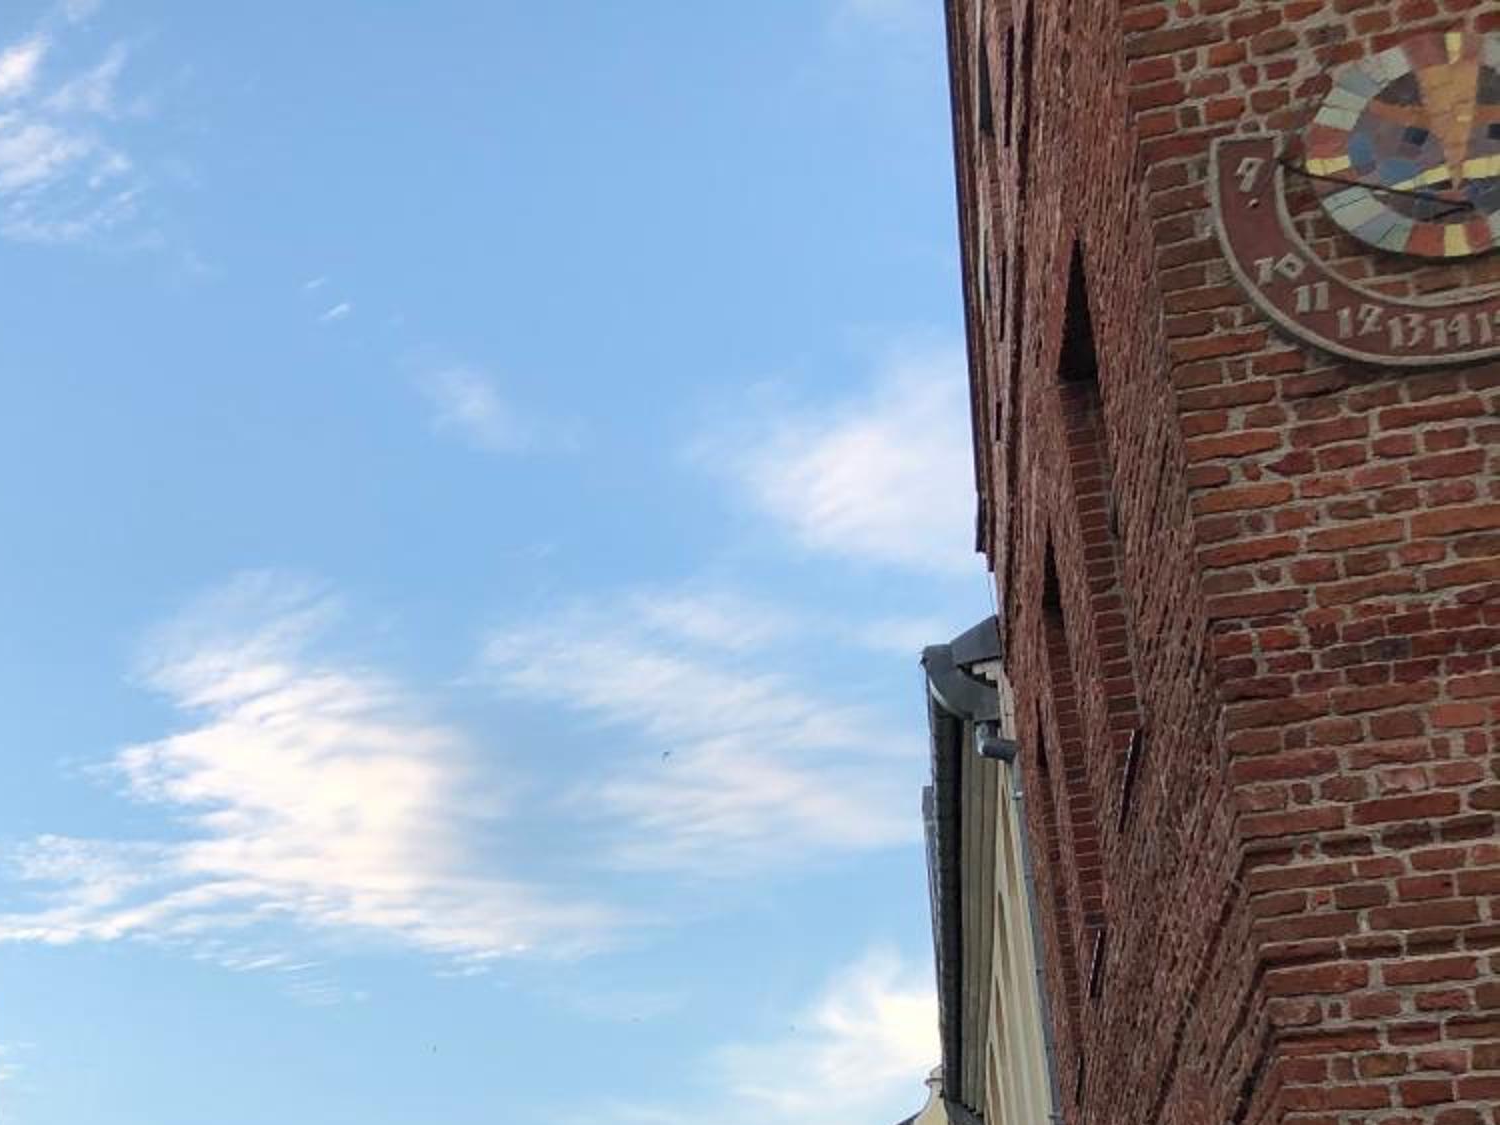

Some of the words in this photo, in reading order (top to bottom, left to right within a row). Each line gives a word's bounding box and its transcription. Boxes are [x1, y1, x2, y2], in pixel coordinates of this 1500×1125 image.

[1254, 253, 1305, 286] 10
[1293, 281, 1329, 313] 11
[1337, 303, 1384, 338] 12
[1388, 313, 1426, 349] 13
[1431, 313, 1471, 349] 14
[1476, 312, 1500, 344] 1
